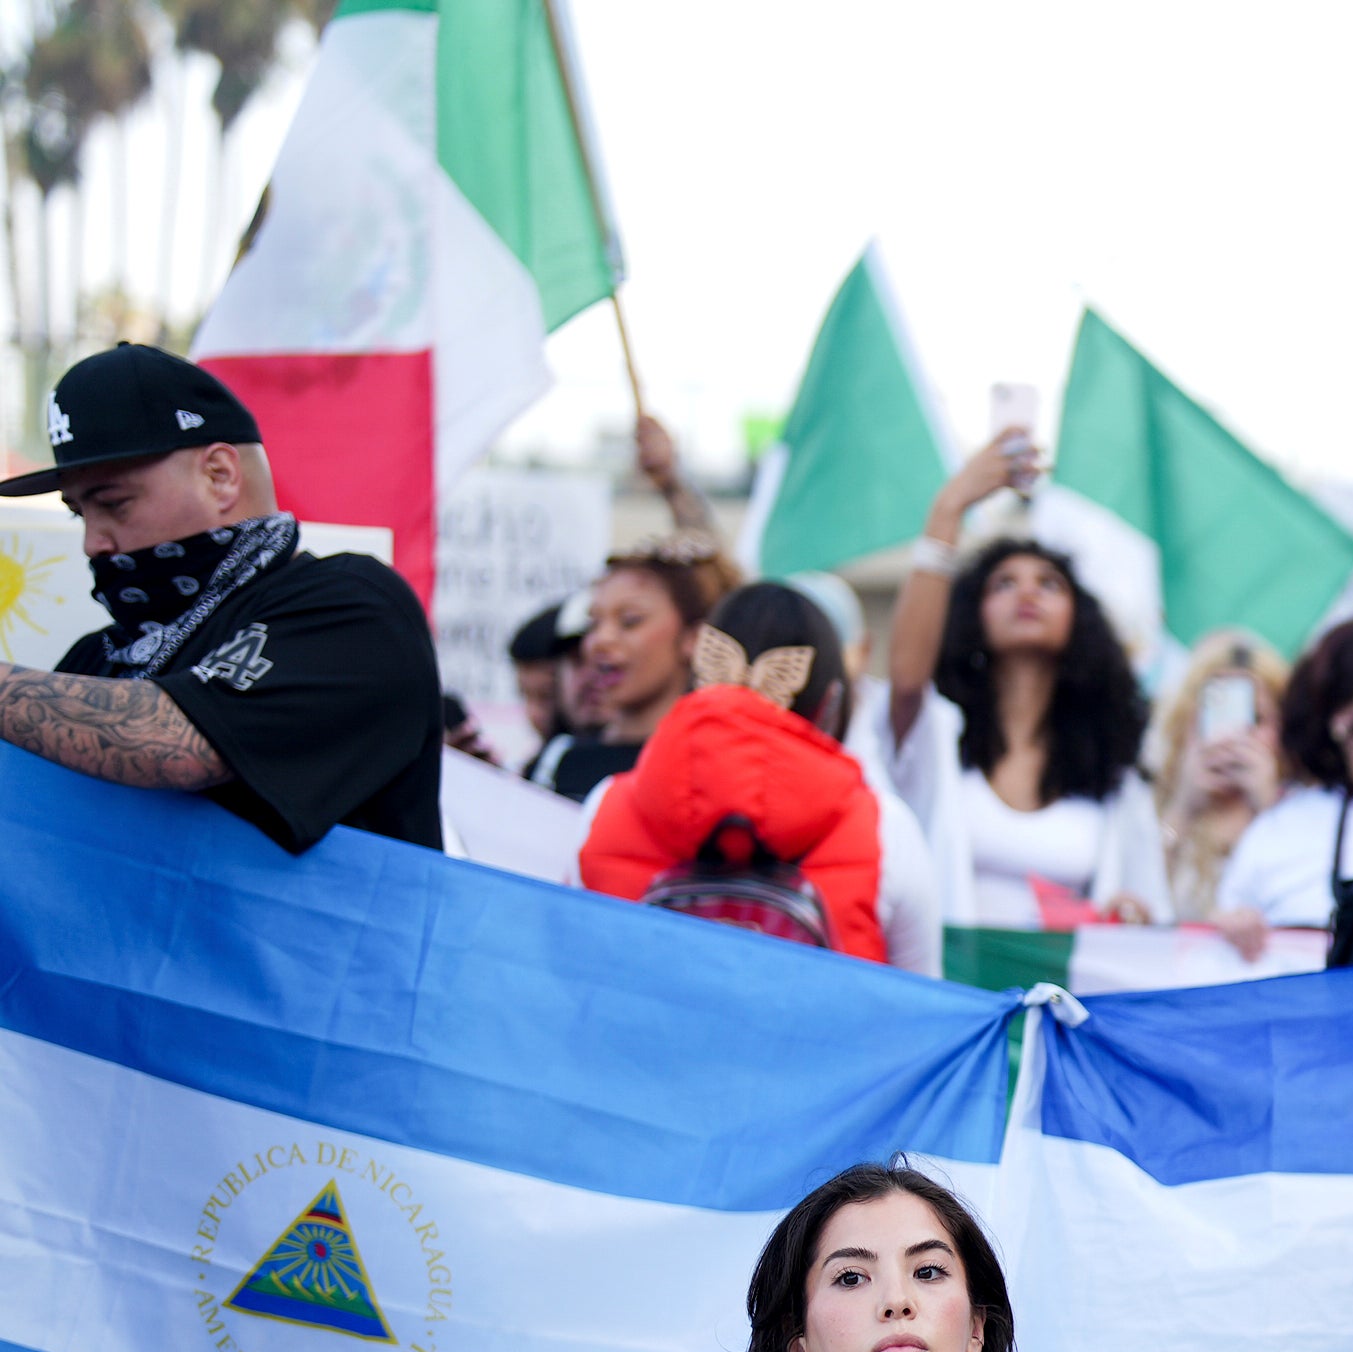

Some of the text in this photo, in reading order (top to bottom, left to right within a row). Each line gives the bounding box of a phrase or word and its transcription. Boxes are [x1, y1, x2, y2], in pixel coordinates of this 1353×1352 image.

[191, 1141, 453, 1323] REPUBLICA DE NICARAGUA
